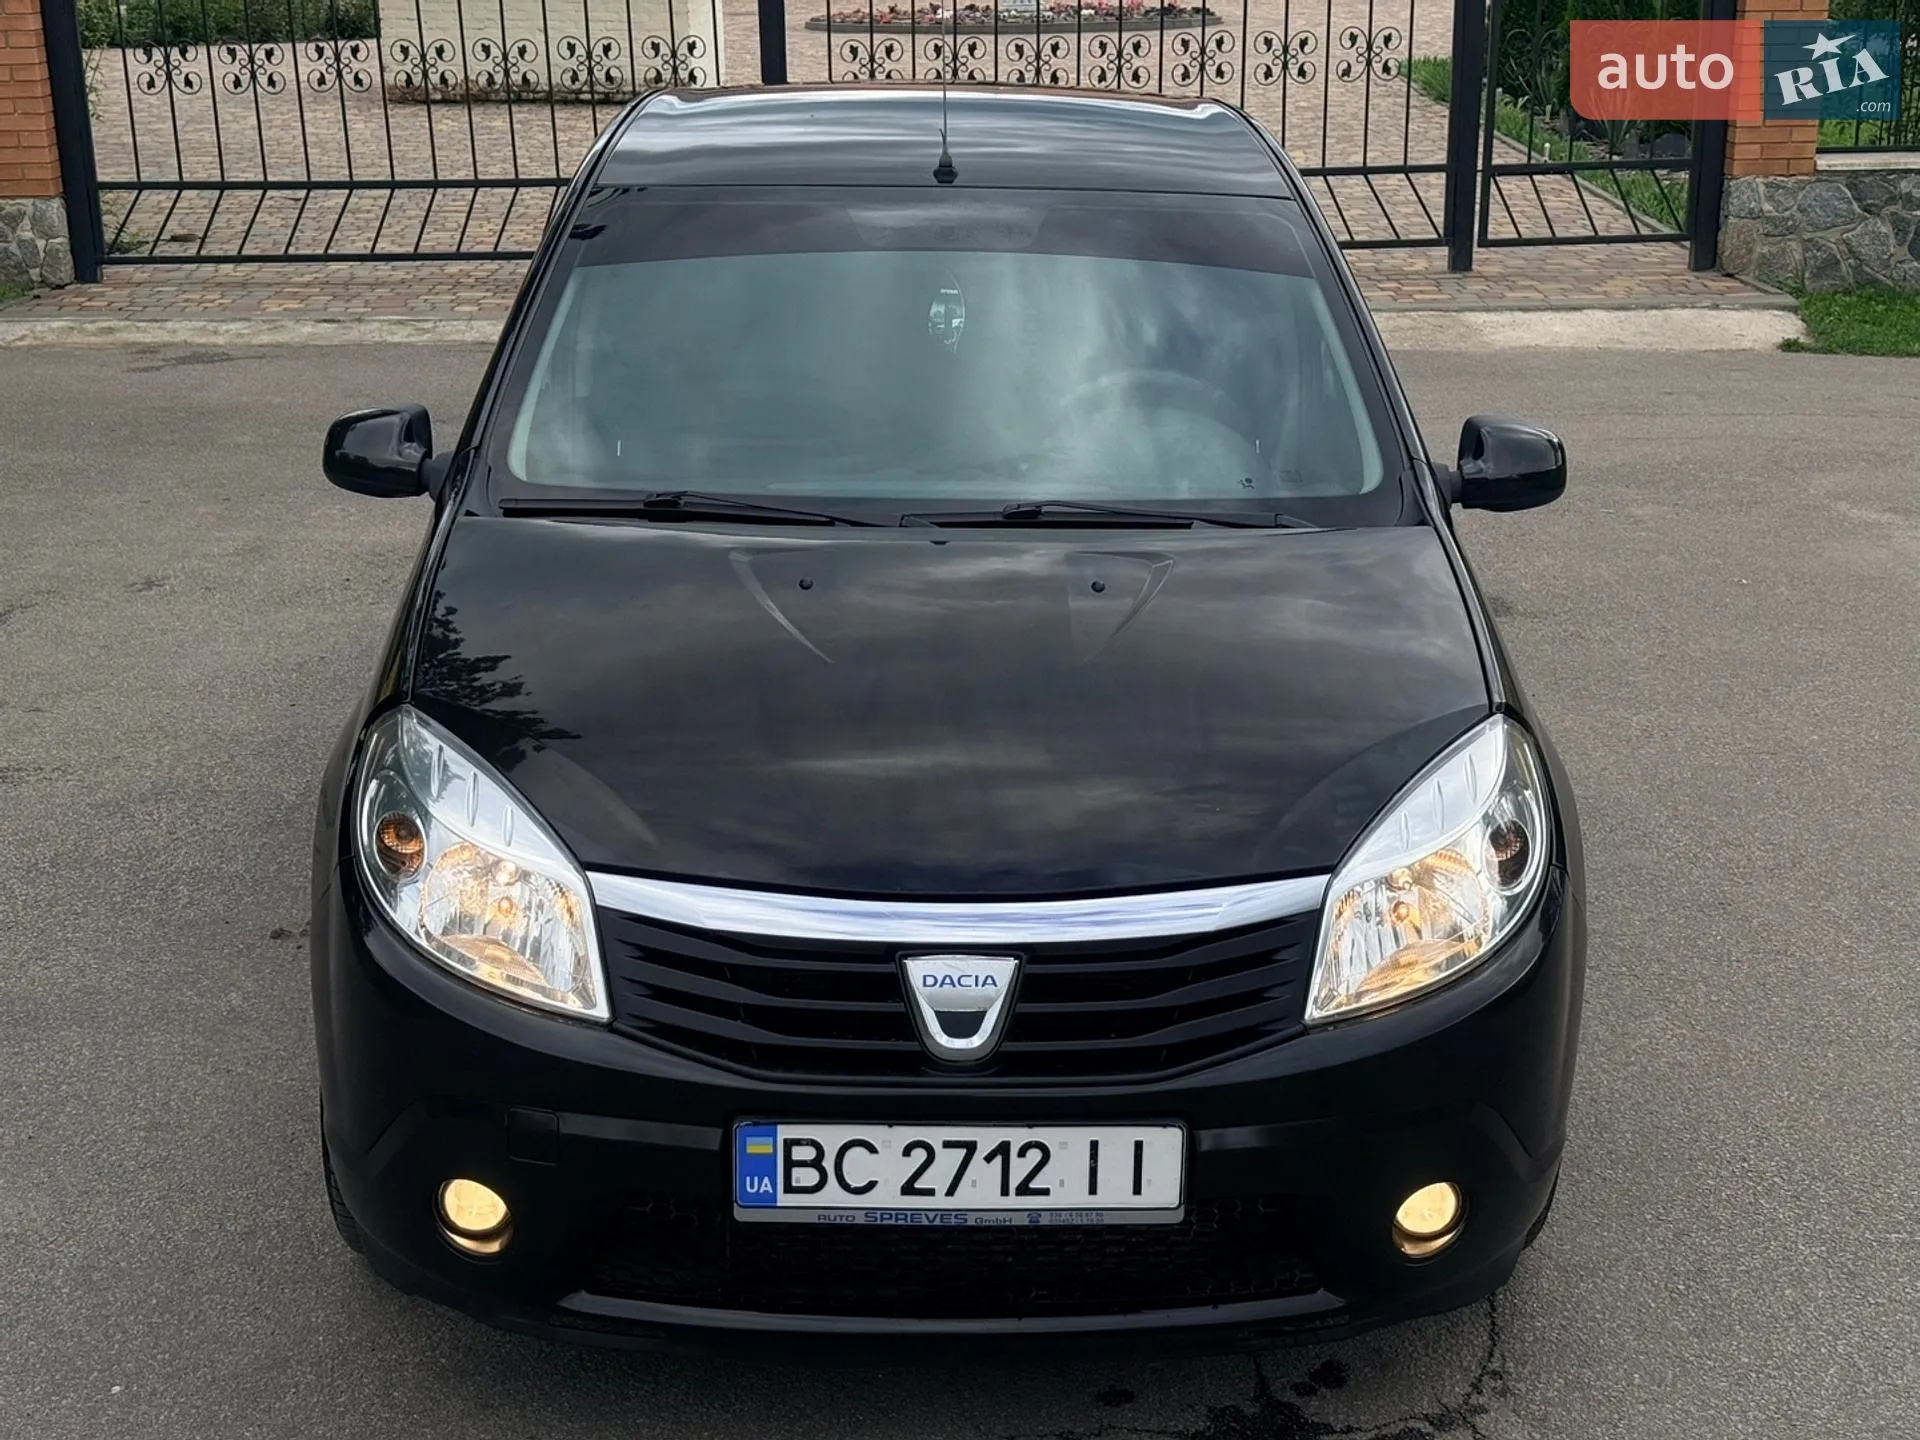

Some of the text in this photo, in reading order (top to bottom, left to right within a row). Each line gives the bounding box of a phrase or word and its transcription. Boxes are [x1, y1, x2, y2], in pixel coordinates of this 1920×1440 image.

[922, 974, 998, 988] DACIA
[782, 1138, 879, 1195] BC
[900, 1140, 1051, 1197] 2712
[745, 1176, 773, 1193] UA
[817, 1211, 1012, 1225] AUTO SPREVES GmbH
